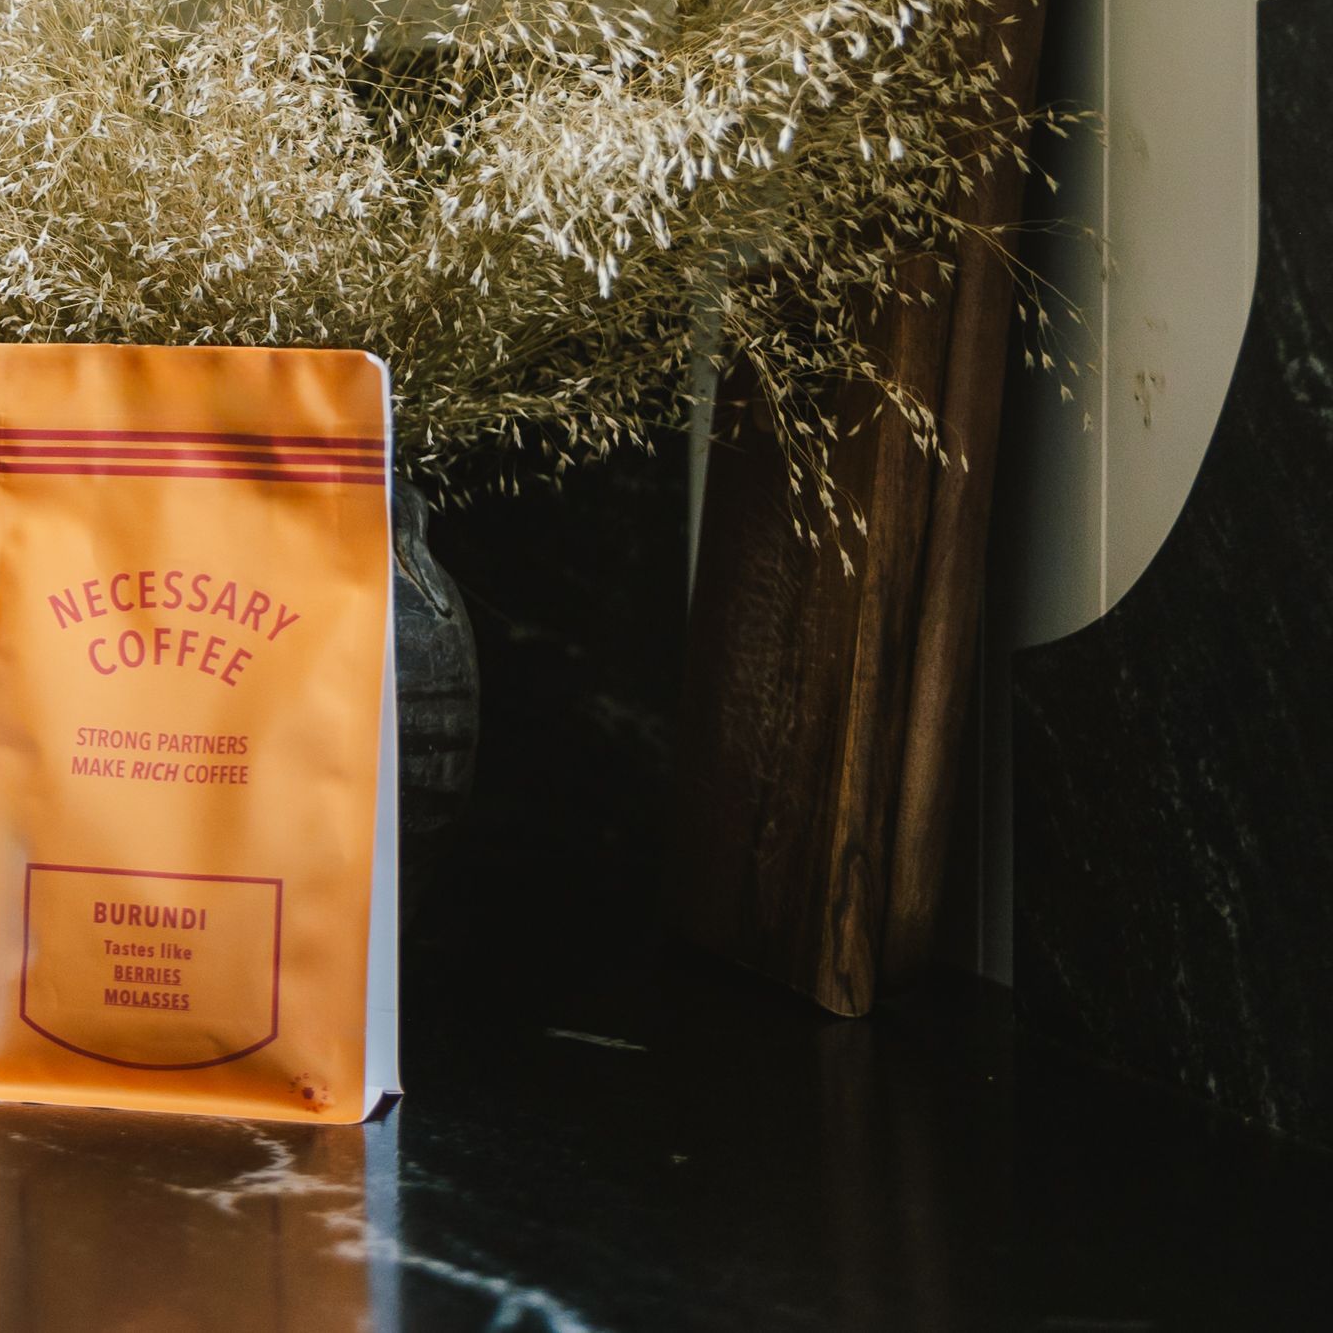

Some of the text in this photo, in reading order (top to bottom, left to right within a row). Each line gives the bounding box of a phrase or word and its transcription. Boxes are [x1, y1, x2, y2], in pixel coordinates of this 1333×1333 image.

[48, 571, 300, 642] NECESSARY
[89, 627, 253, 686] COFFEE
[77, 727, 248, 755] STRONG PARTNERS
[72, 757, 248, 784] MAKE RICH COFFEE
[94, 902, 205, 930] BURUNDI
[104, 940, 192, 960] Tastes like
[115, 965, 181, 985] BERRIES
[105, 988, 189, 1010] MOLASSES
